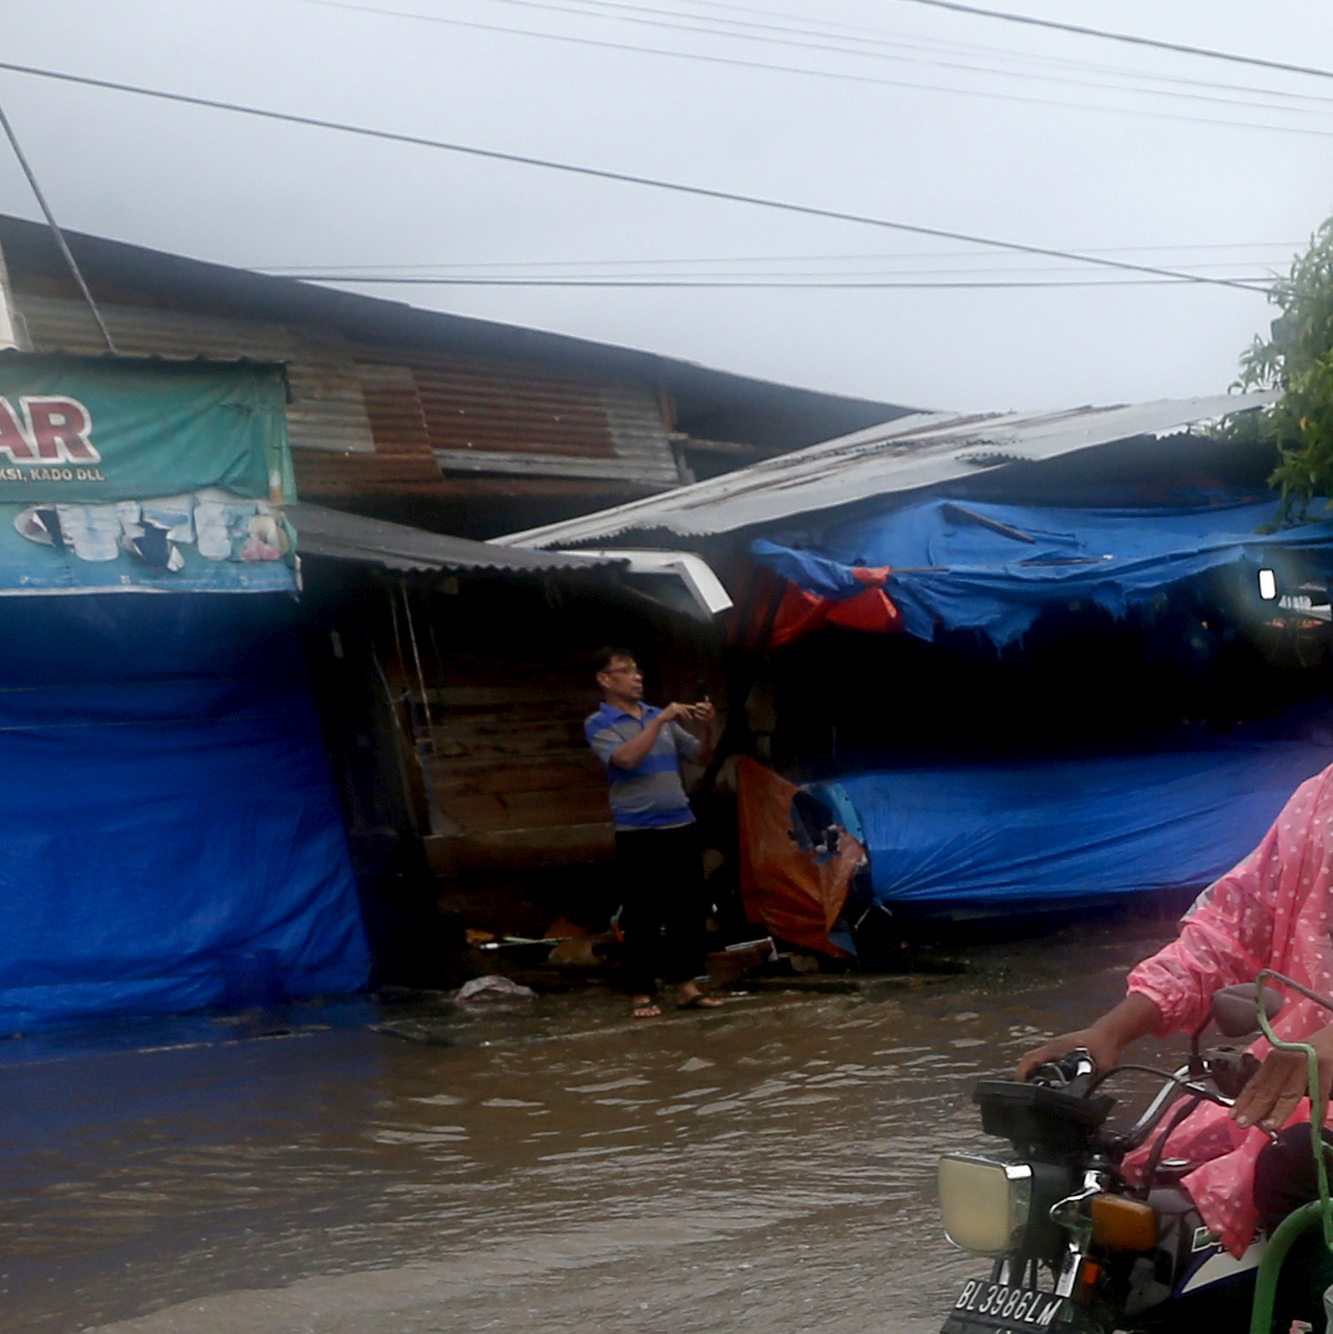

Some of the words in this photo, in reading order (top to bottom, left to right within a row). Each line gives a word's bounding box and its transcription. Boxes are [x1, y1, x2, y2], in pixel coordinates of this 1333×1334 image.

[30, 467, 73, 481] KADO
[76, 468, 105, 481] DLL
[955, 1280, 984, 1311] BL
[978, 1284, 1032, 1320] 3986
[1024, 1294, 1063, 1326] LM
